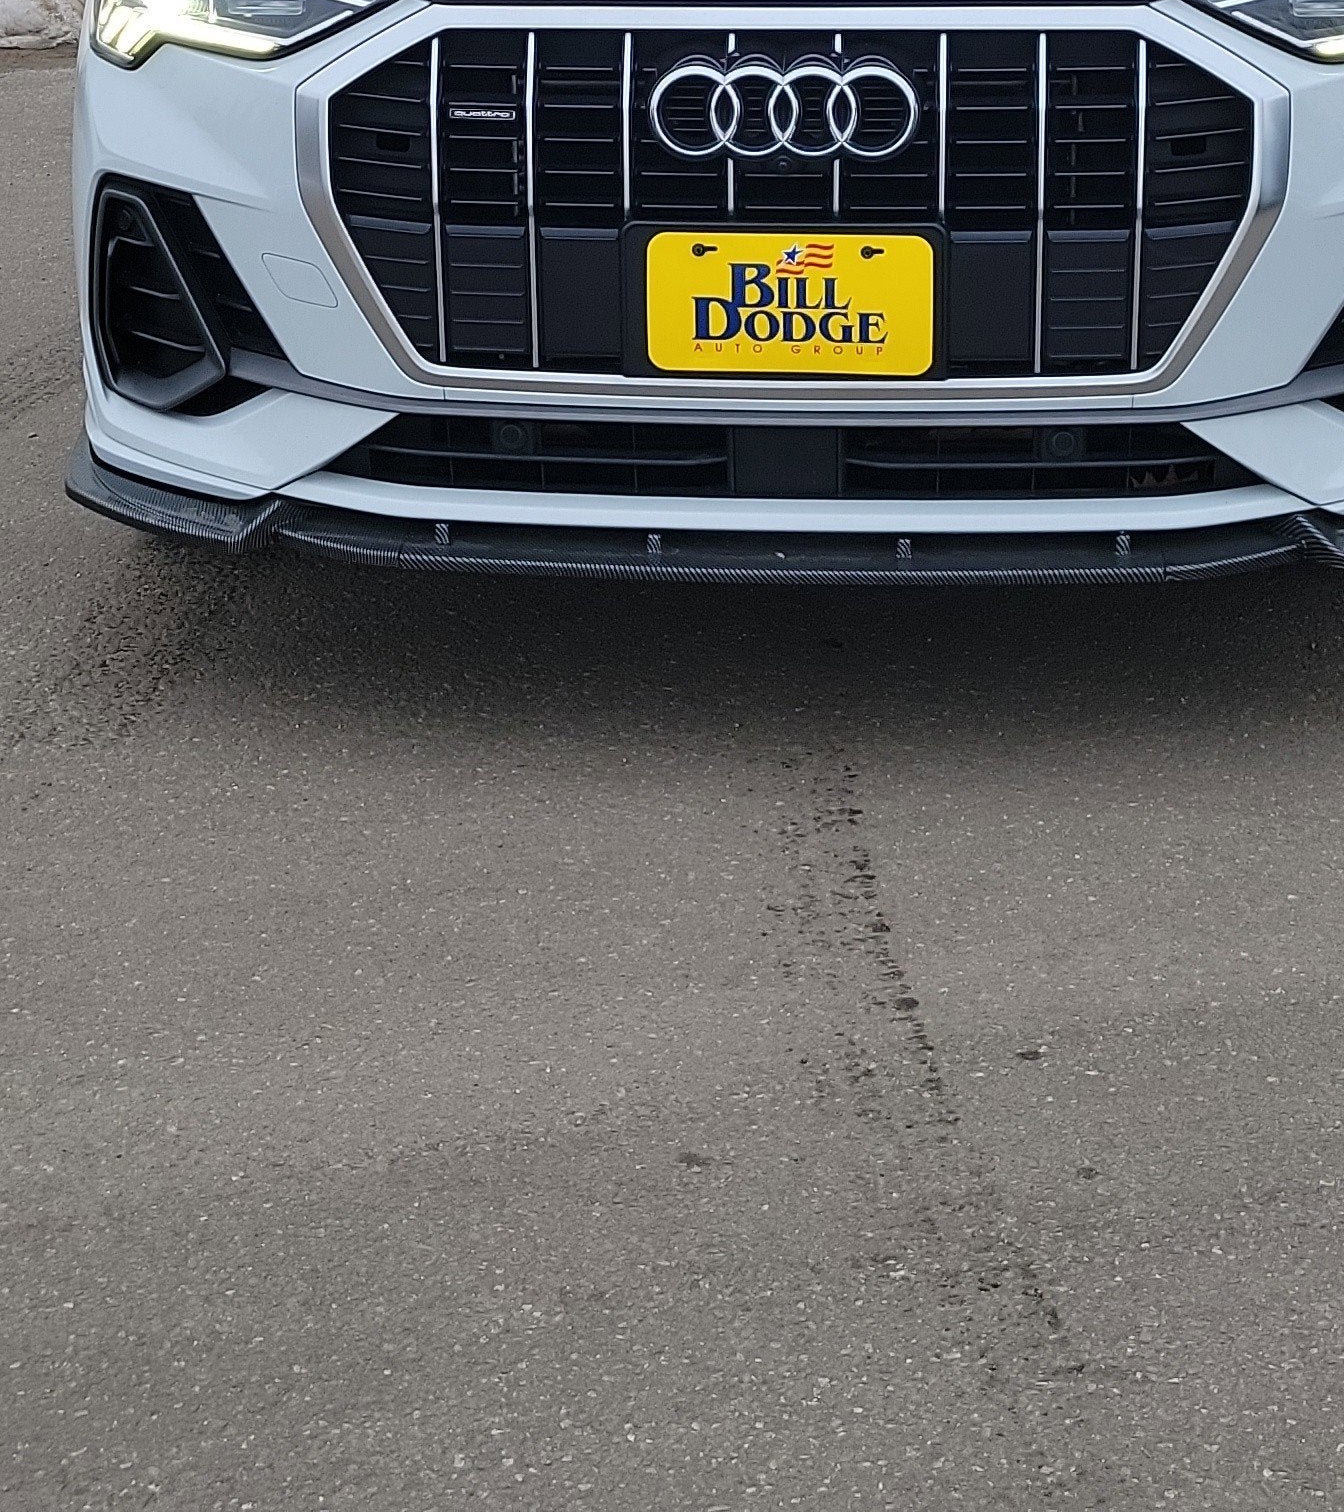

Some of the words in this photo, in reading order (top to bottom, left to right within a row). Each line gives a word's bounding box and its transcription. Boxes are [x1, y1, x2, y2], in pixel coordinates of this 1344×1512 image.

[453, 109, 511, 119] quattro
[728, 262, 852, 310] BILL
[691, 296, 889, 345] DODGE
[693, 343, 763, 354] AUTO
[791, 345, 885, 356] GROUP
